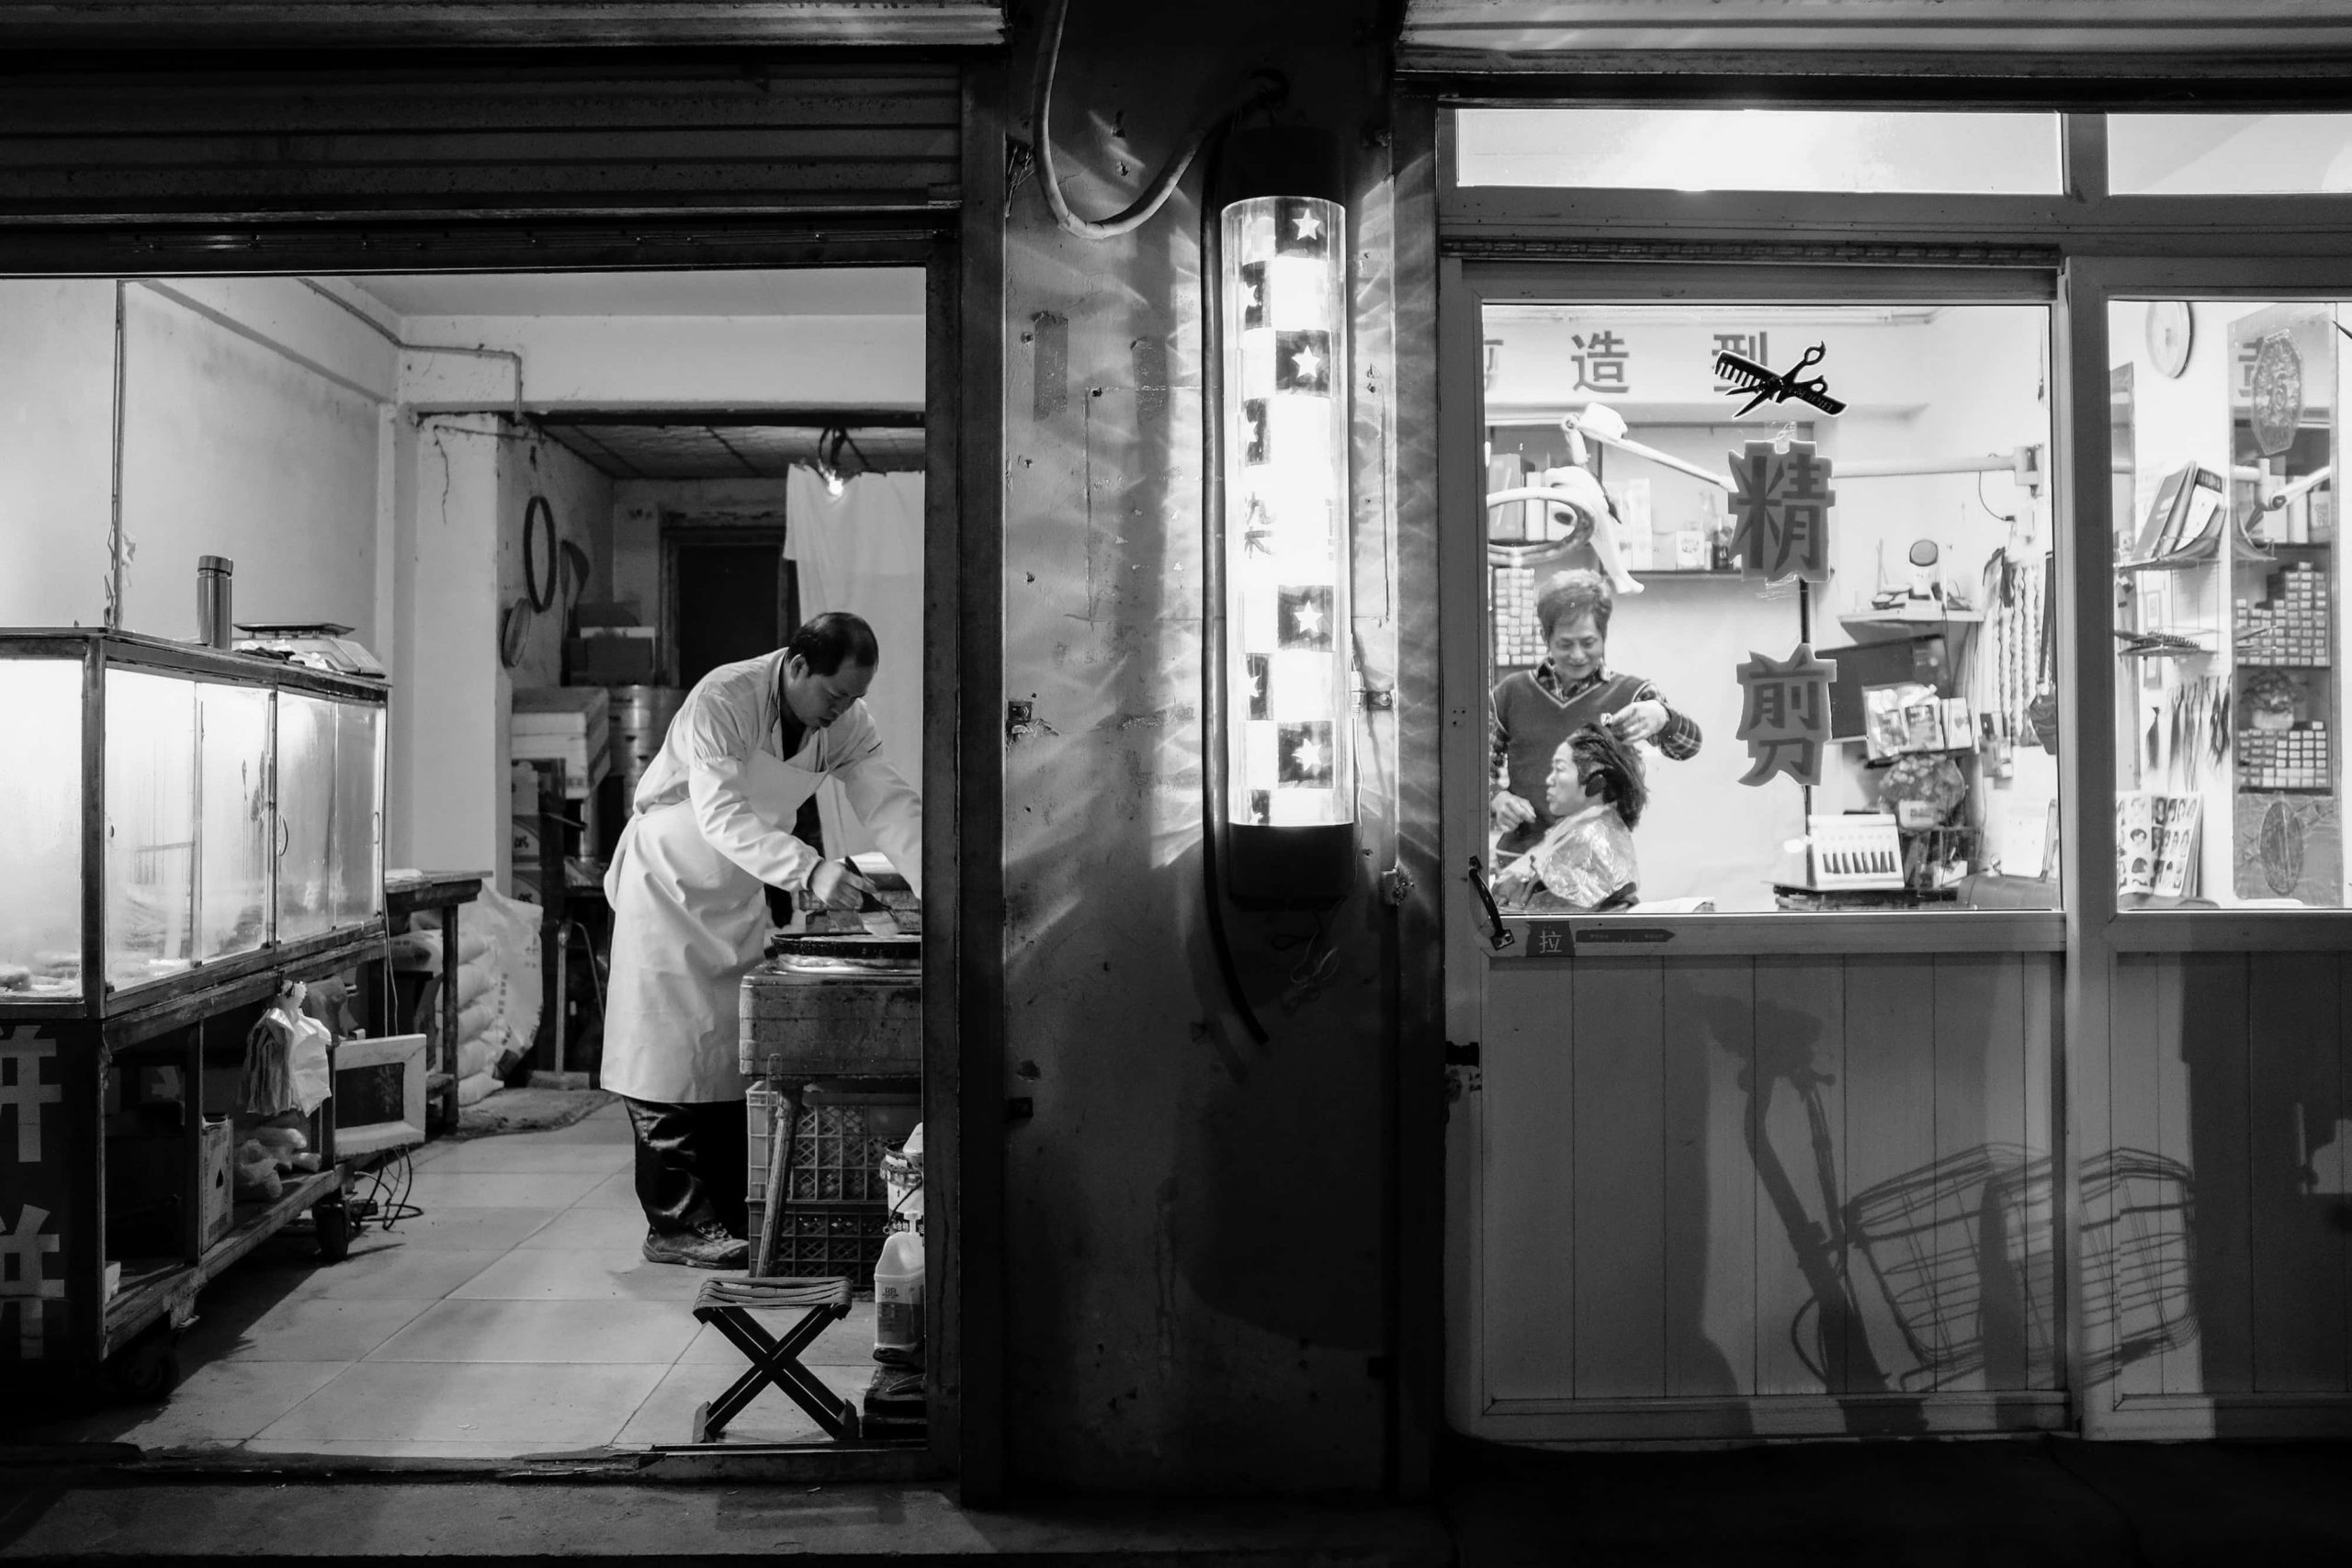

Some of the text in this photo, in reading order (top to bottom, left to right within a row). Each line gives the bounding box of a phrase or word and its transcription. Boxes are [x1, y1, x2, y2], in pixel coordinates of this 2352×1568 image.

[1485, 331, 1769, 393] 造型
[1735, 452, 1827, 778] 精剪
[1539, 930, 1563, 953] 拉
